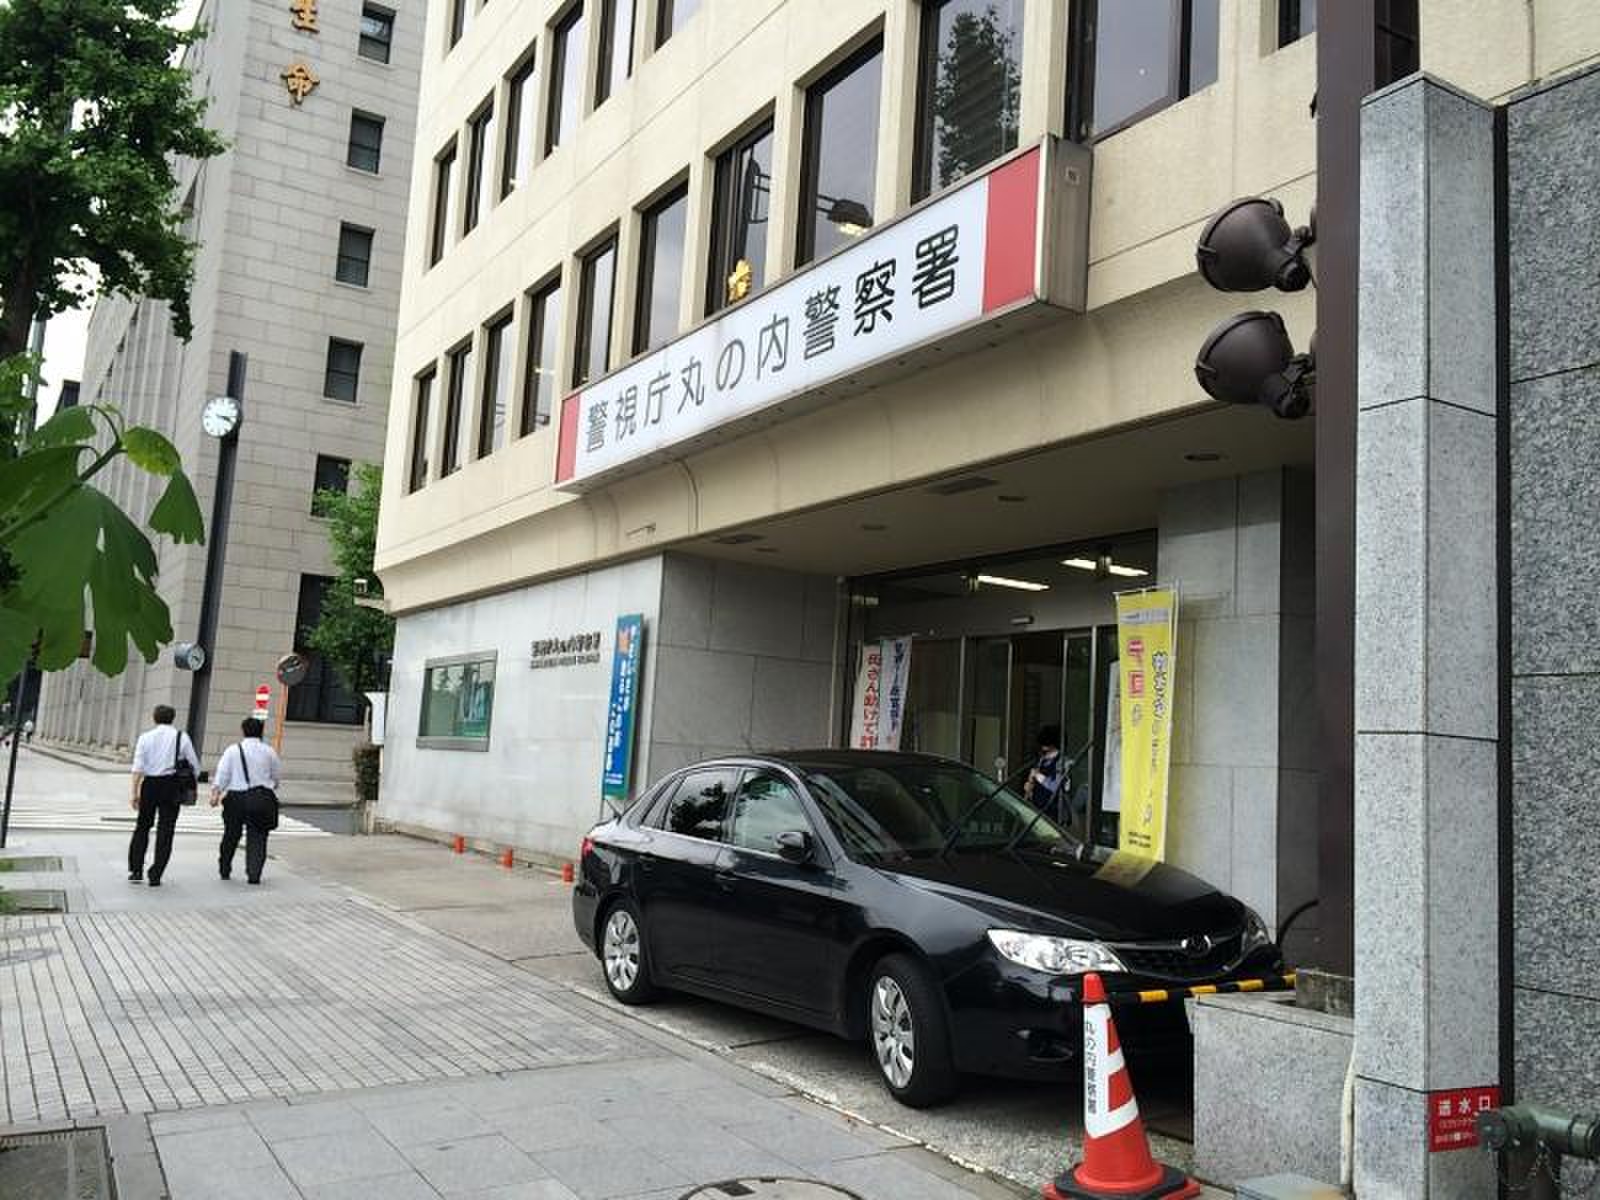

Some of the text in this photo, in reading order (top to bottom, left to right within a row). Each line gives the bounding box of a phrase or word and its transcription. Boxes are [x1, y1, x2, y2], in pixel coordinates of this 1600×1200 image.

[586, 224, 959, 453] 警視庁丸の内警察署
